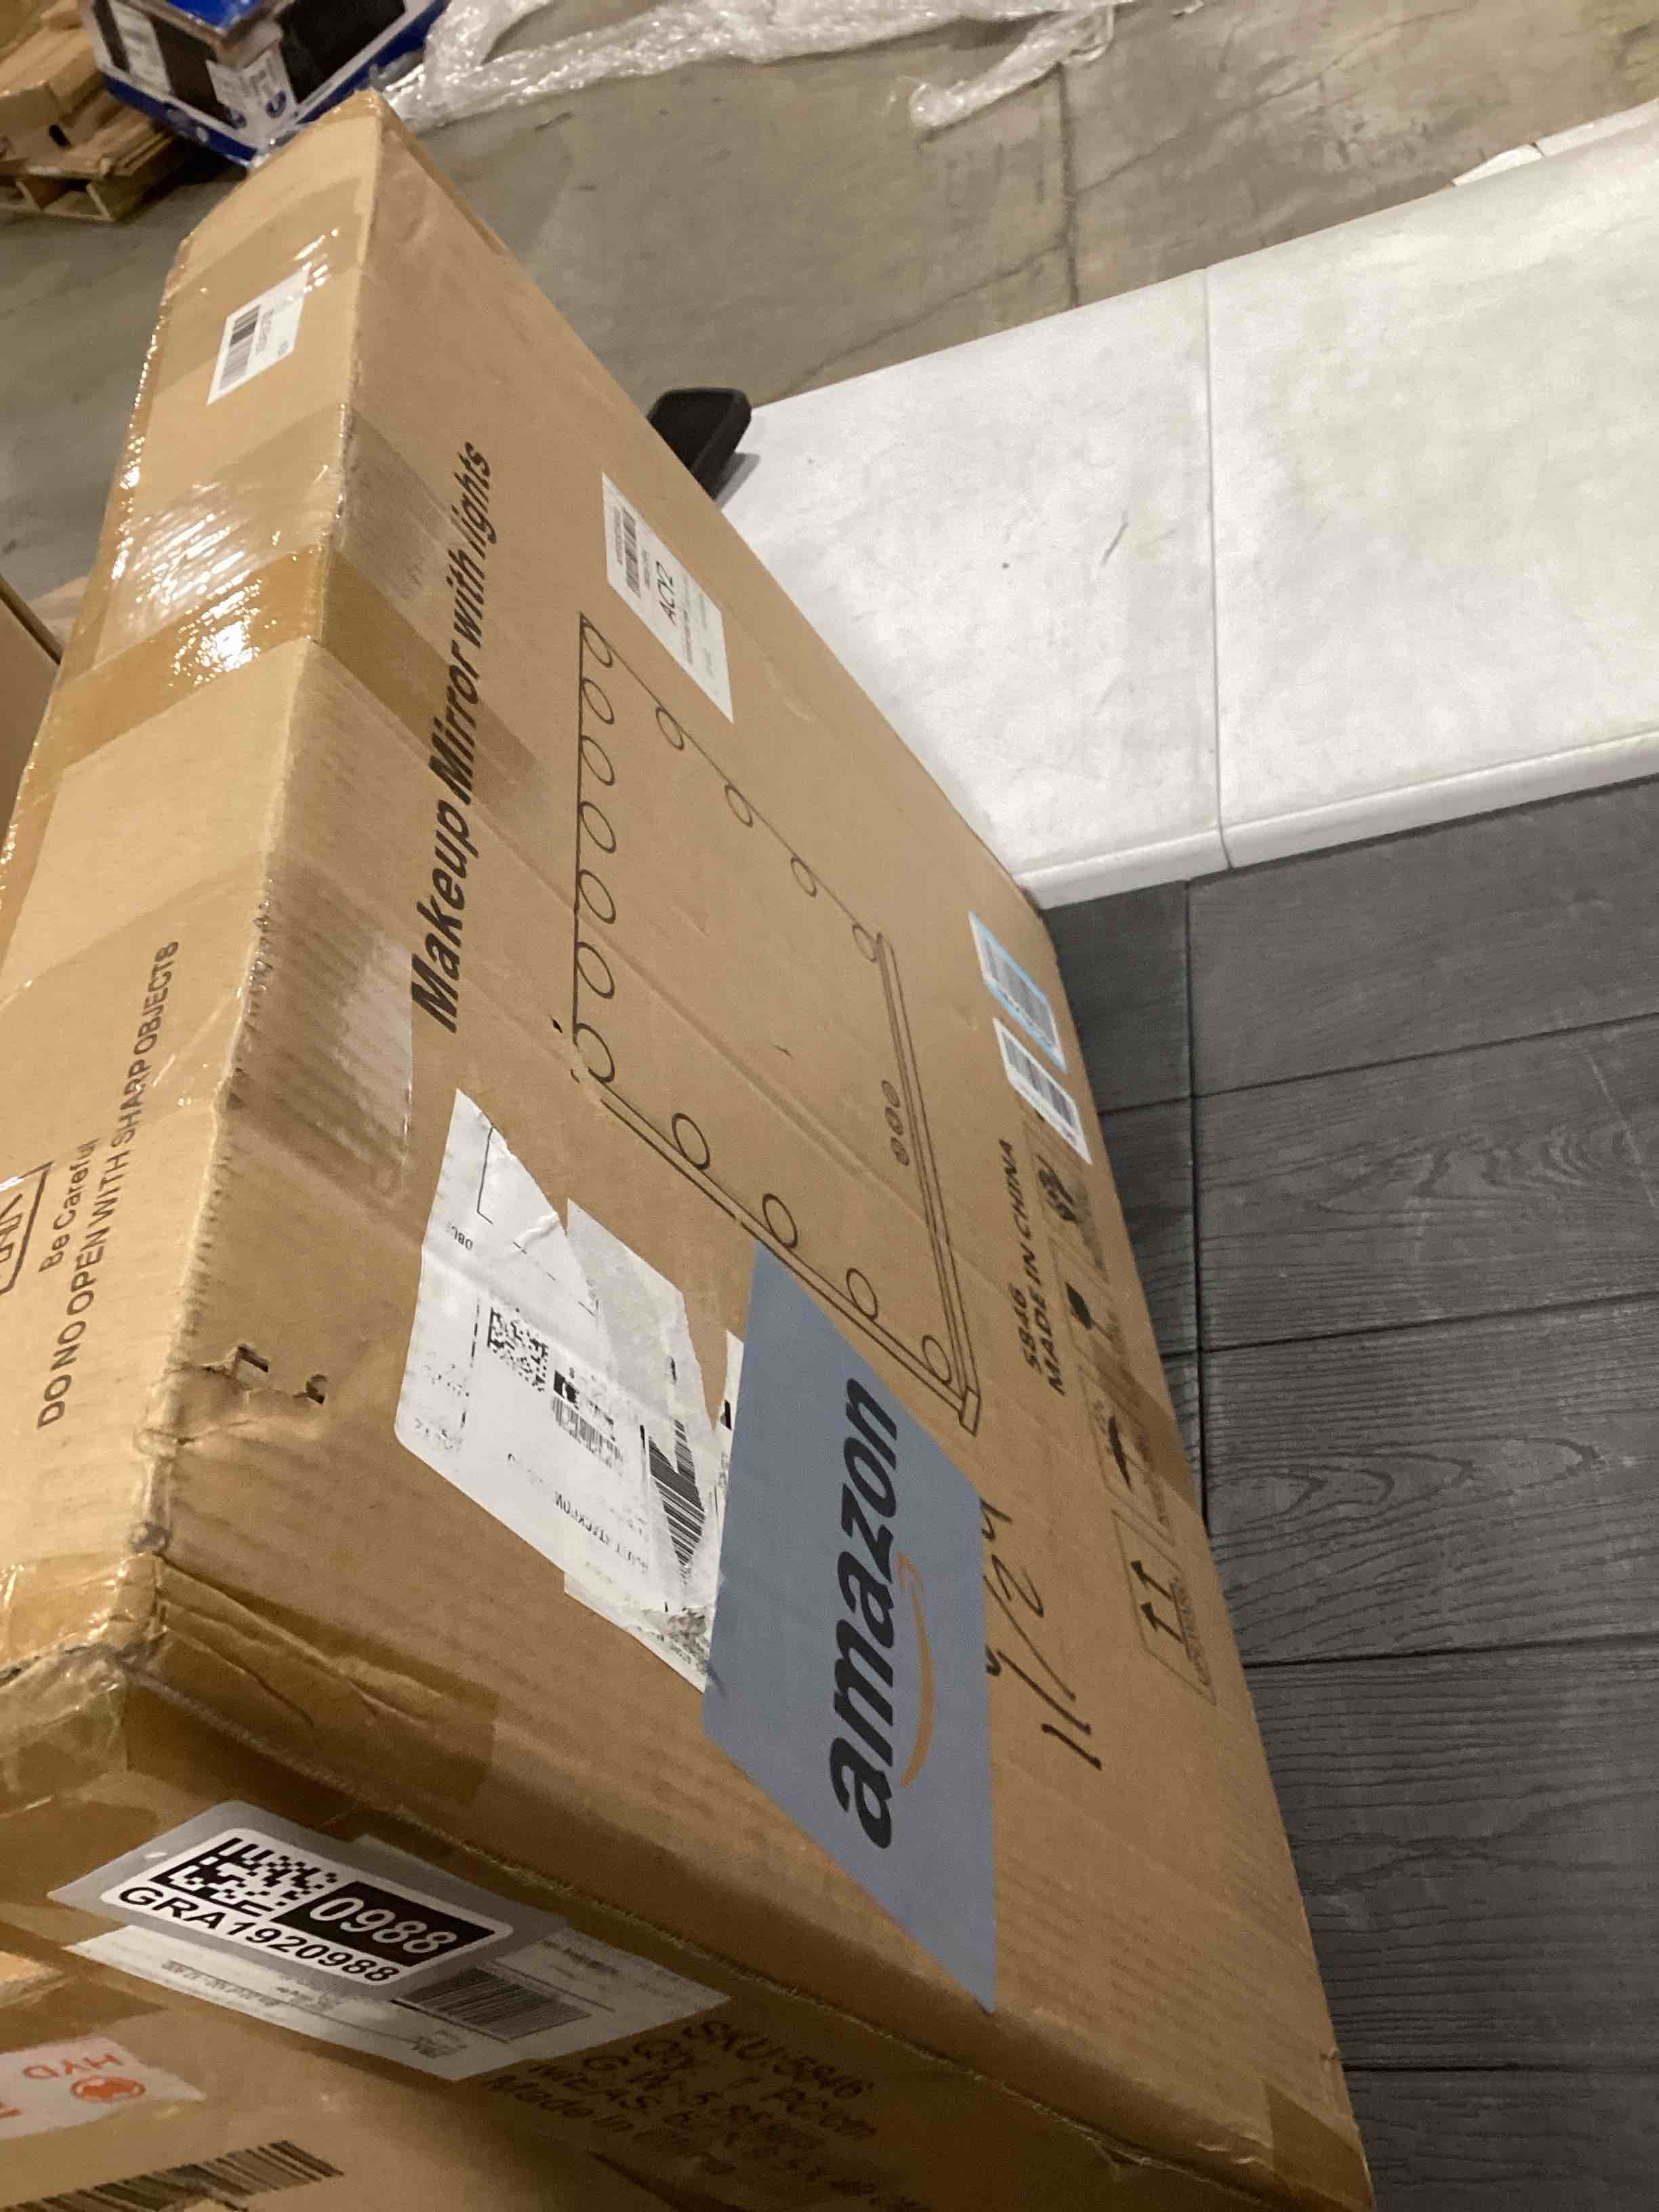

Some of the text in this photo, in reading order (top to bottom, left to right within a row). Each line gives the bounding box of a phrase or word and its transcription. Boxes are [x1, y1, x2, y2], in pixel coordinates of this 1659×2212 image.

[655, 560, 676, 626] ACY2
[411, 442, 497, 1033] Makeup Mirror with lights
[37, 940, 179, 1429] DO NO OPEN WITH SHARP OBJECTS
[39, 1233, 70, 1273] Be
[999, 1139, 1065, 1396] MADE IN CHINA
[828, 1376, 898, 1849] amazon
[118, 1885, 400, 1983] GRA1920988
[308, 1896, 458, 1955] 0988
